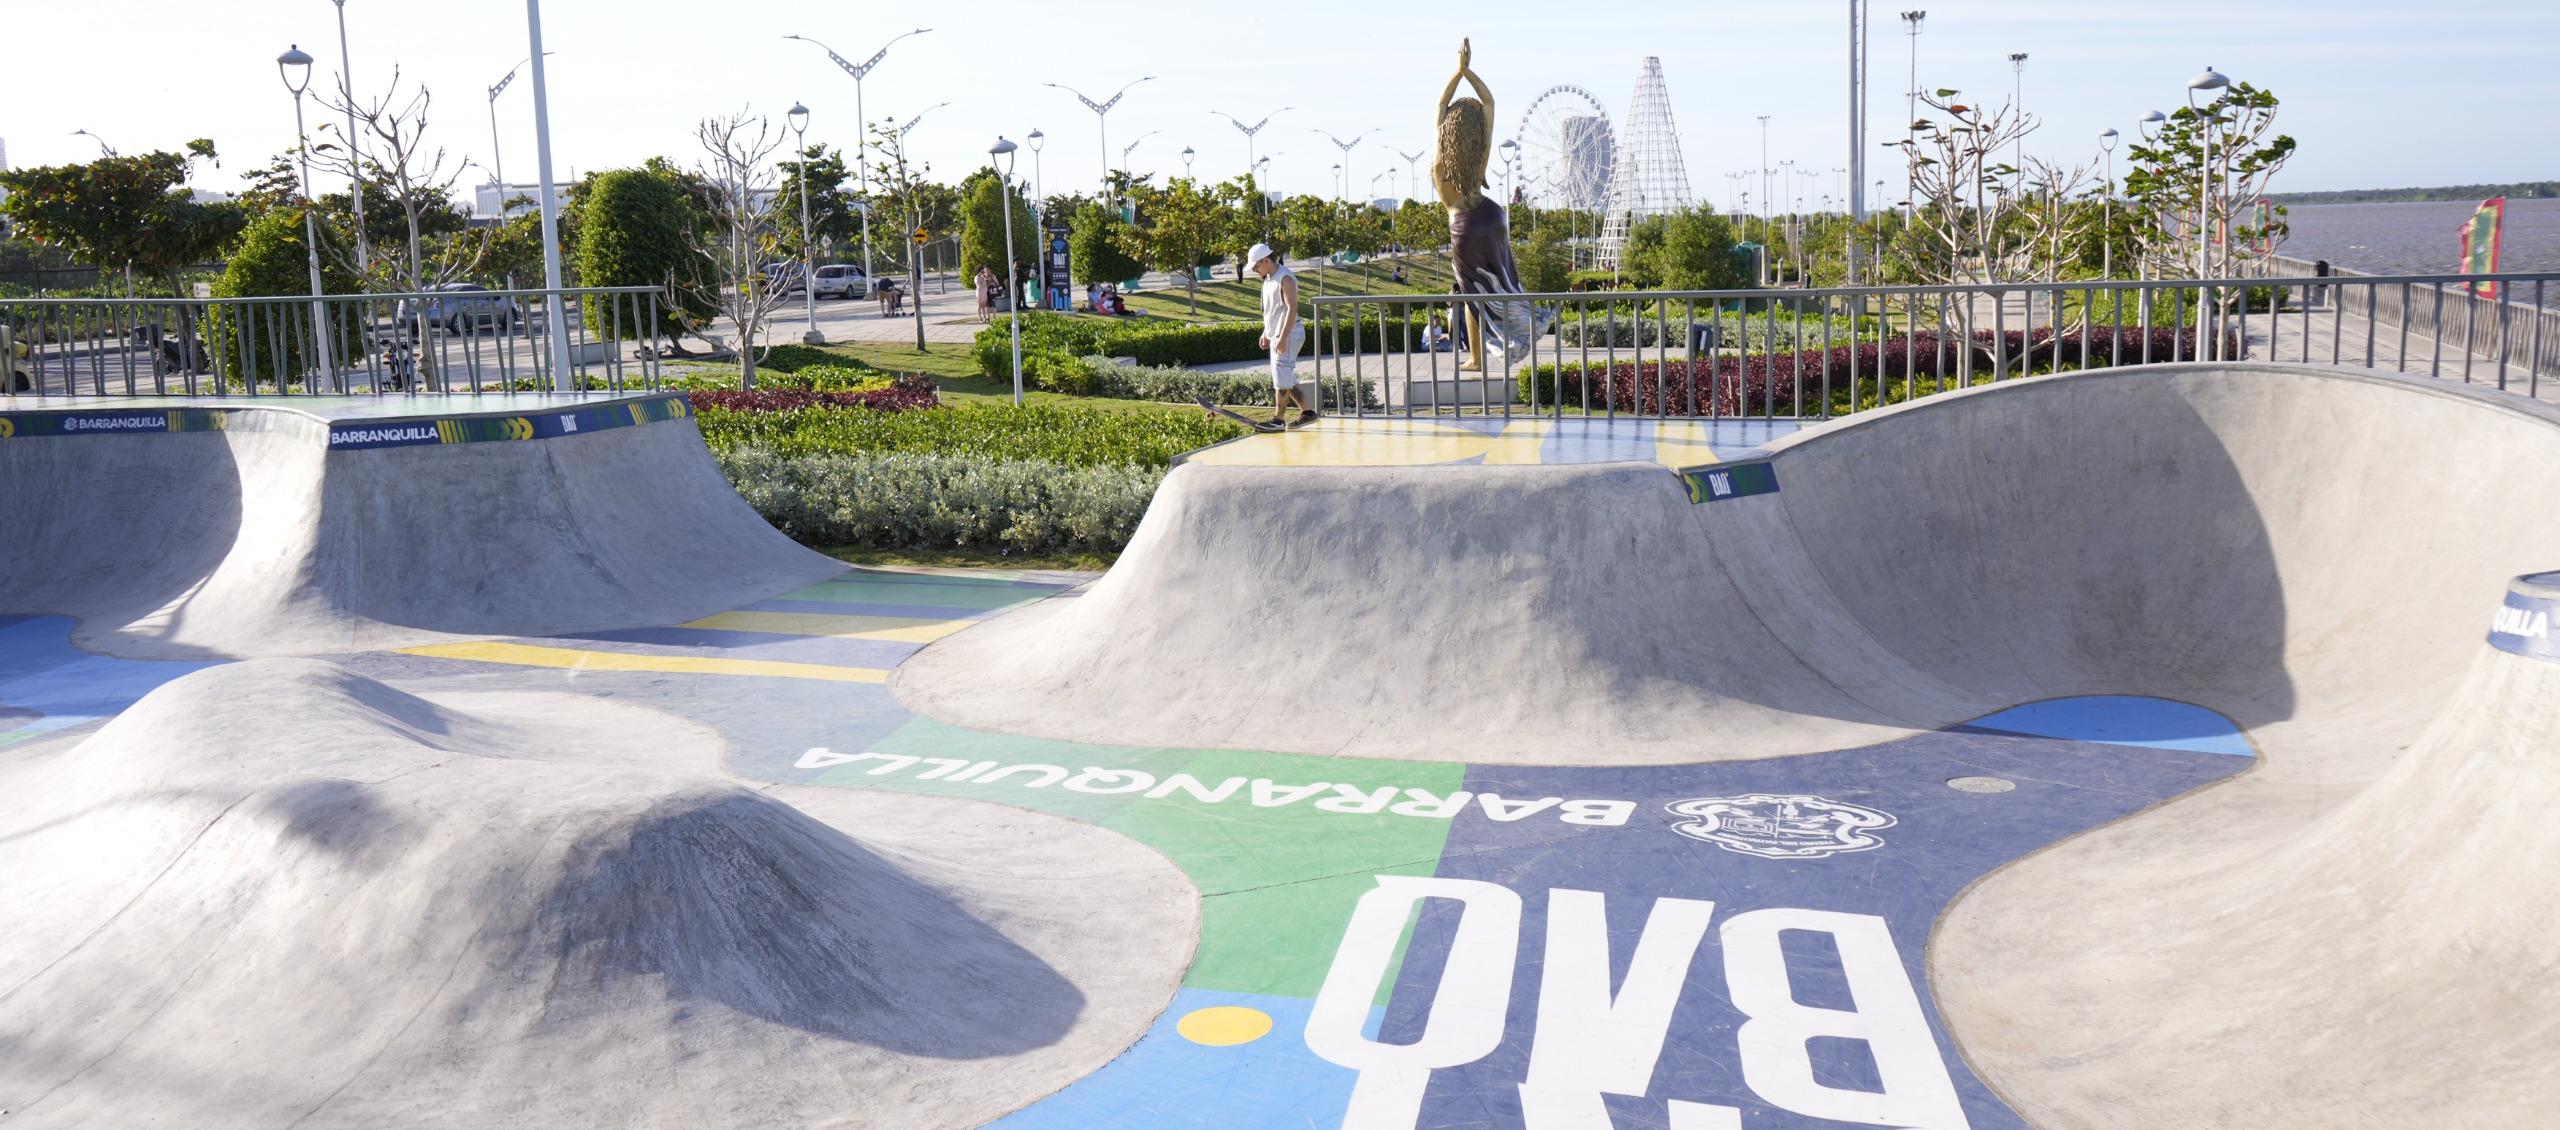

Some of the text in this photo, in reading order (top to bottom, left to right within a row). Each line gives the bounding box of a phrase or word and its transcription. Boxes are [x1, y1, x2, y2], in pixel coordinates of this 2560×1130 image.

[79, 416, 166, 430] BARRANQUILLA
[331, 426, 439, 445] BARRANQUILLA
[793, 746, 1638, 826] BARRANQUILLA
